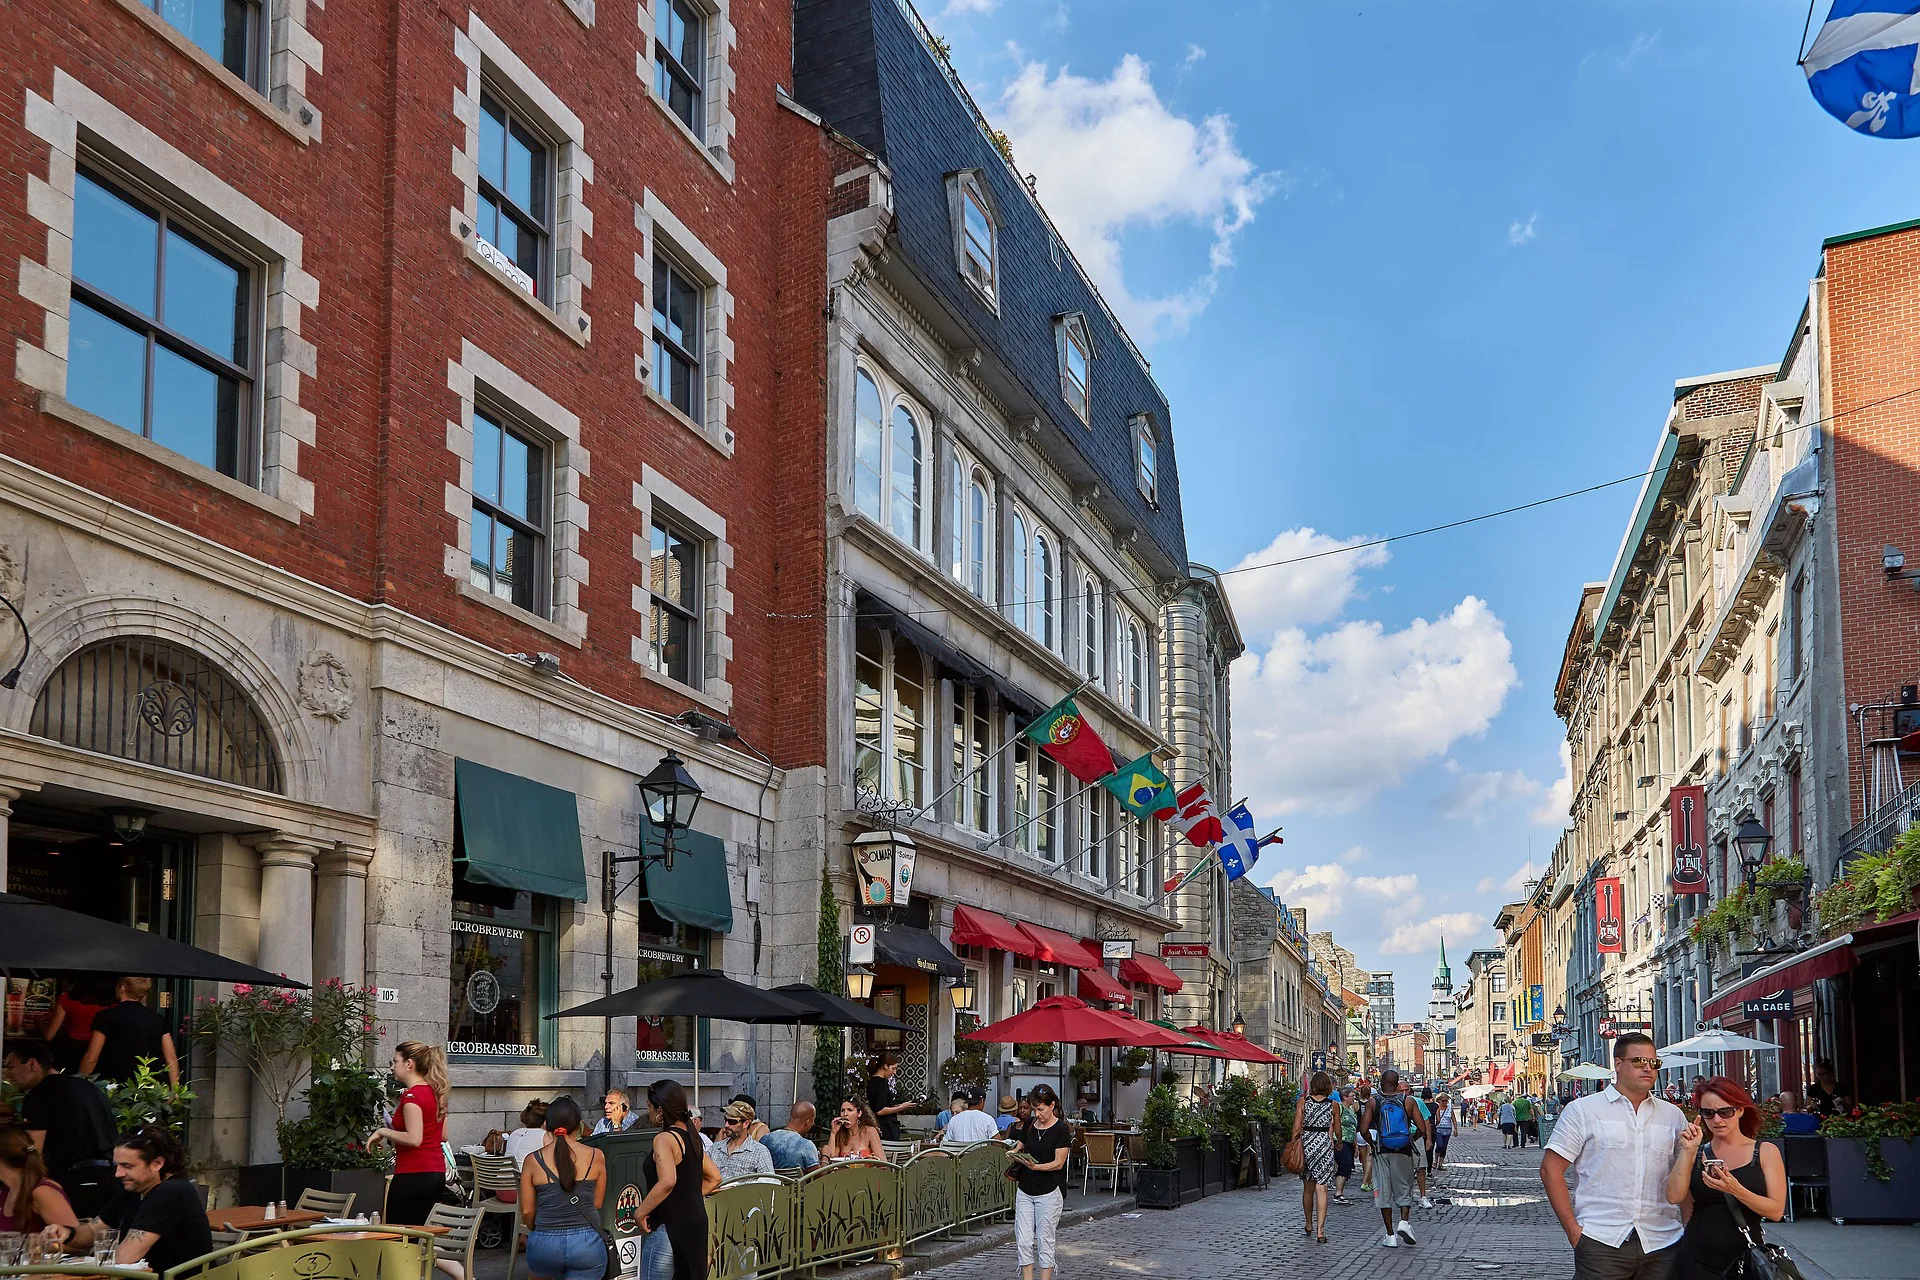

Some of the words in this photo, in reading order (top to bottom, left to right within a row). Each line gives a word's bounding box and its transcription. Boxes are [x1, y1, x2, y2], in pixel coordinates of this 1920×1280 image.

[859, 846, 893, 865] SOLMAR
[1686, 858, 1703, 874] PAUL
[382, 990, 394, 1001] 105
[1747, 1003, 1760, 1012] LA
[1762, 1003, 1791, 1011] CAGE
